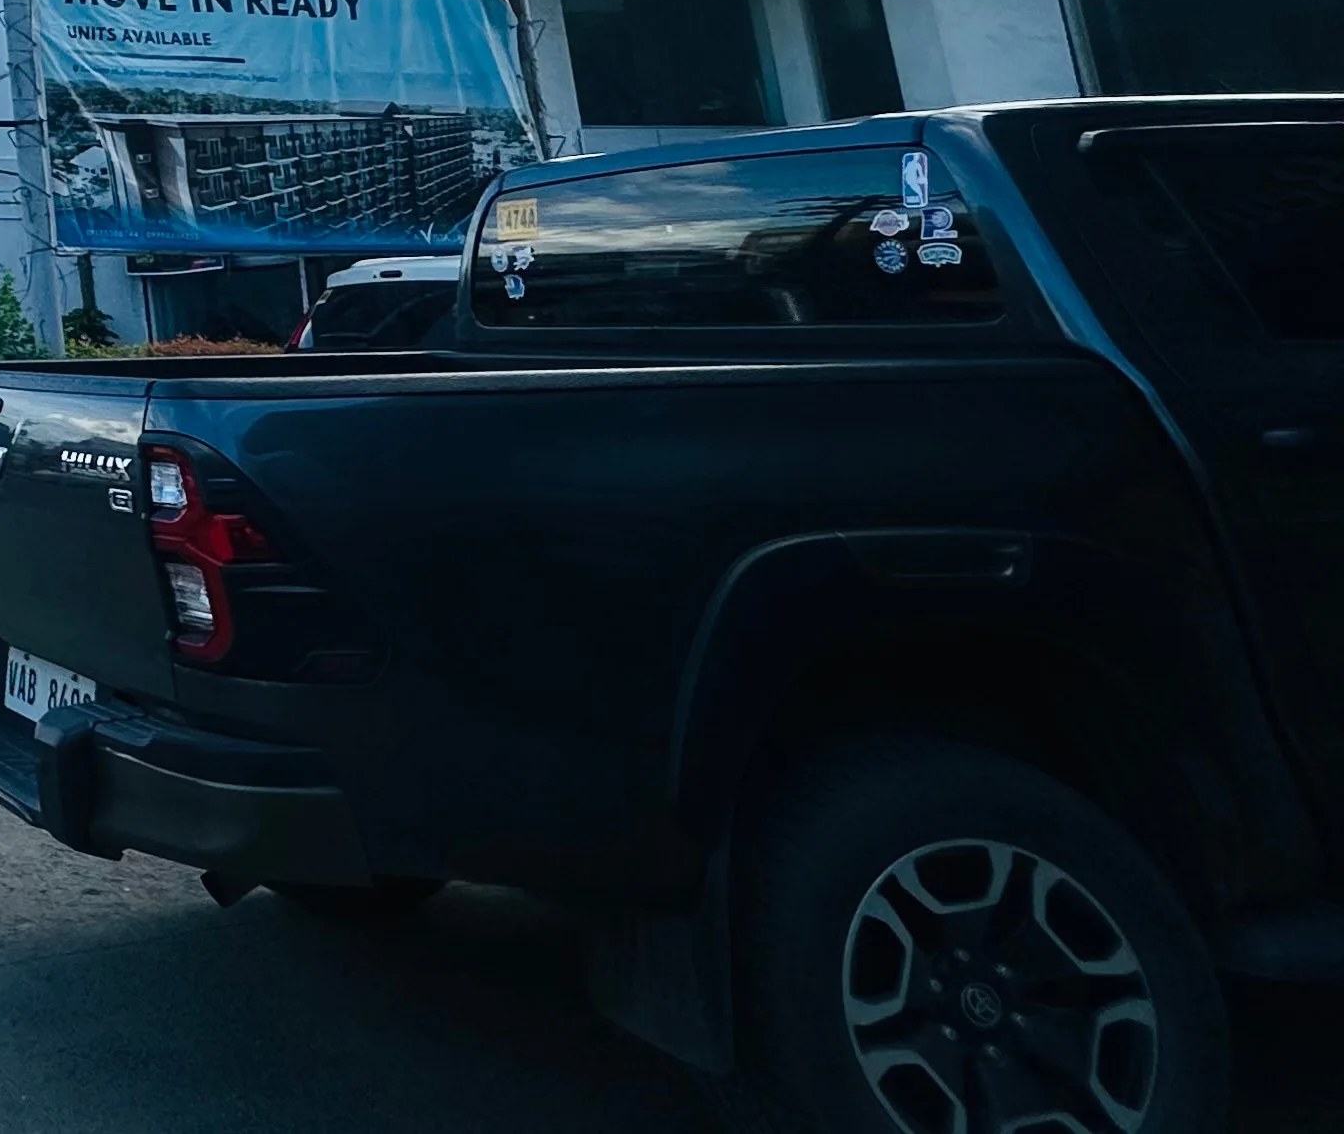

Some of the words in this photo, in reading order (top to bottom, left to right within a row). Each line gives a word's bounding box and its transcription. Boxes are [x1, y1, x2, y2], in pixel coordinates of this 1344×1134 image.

[67, 24, 118, 44] UNITS
[122, 28, 212, 48] AVAILABLE
[60, 450, 133, 482] HILUX
[9, 659, 37, 706] VAB
